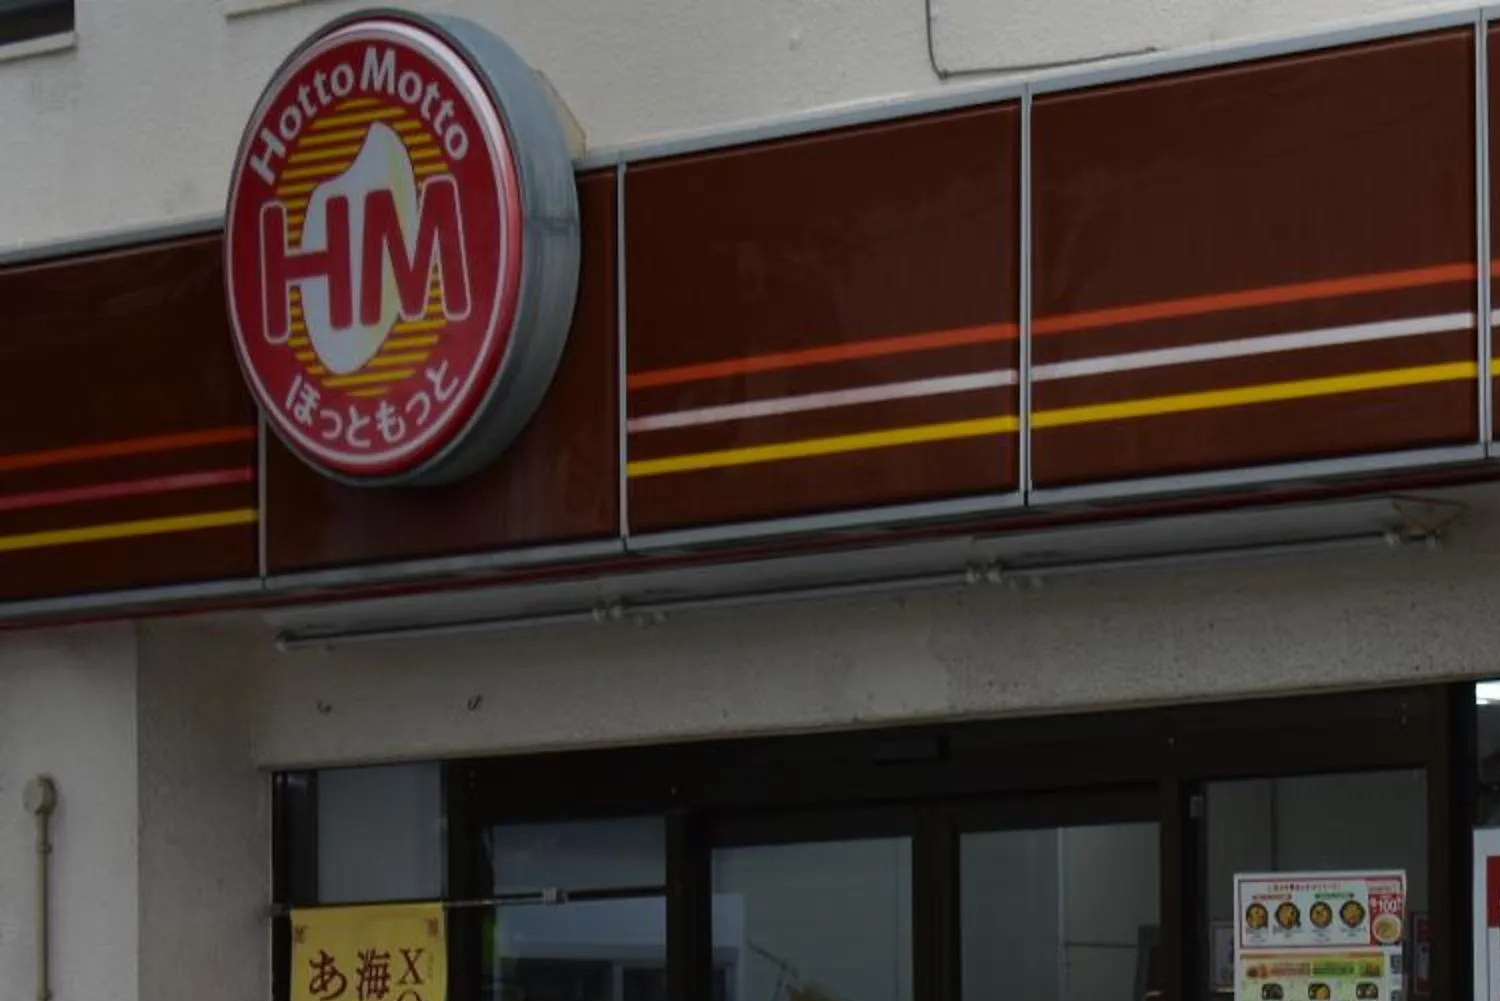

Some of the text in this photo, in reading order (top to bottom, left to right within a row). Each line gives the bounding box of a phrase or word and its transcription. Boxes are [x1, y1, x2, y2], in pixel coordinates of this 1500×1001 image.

[285, 359, 460, 448] ほっともっと
